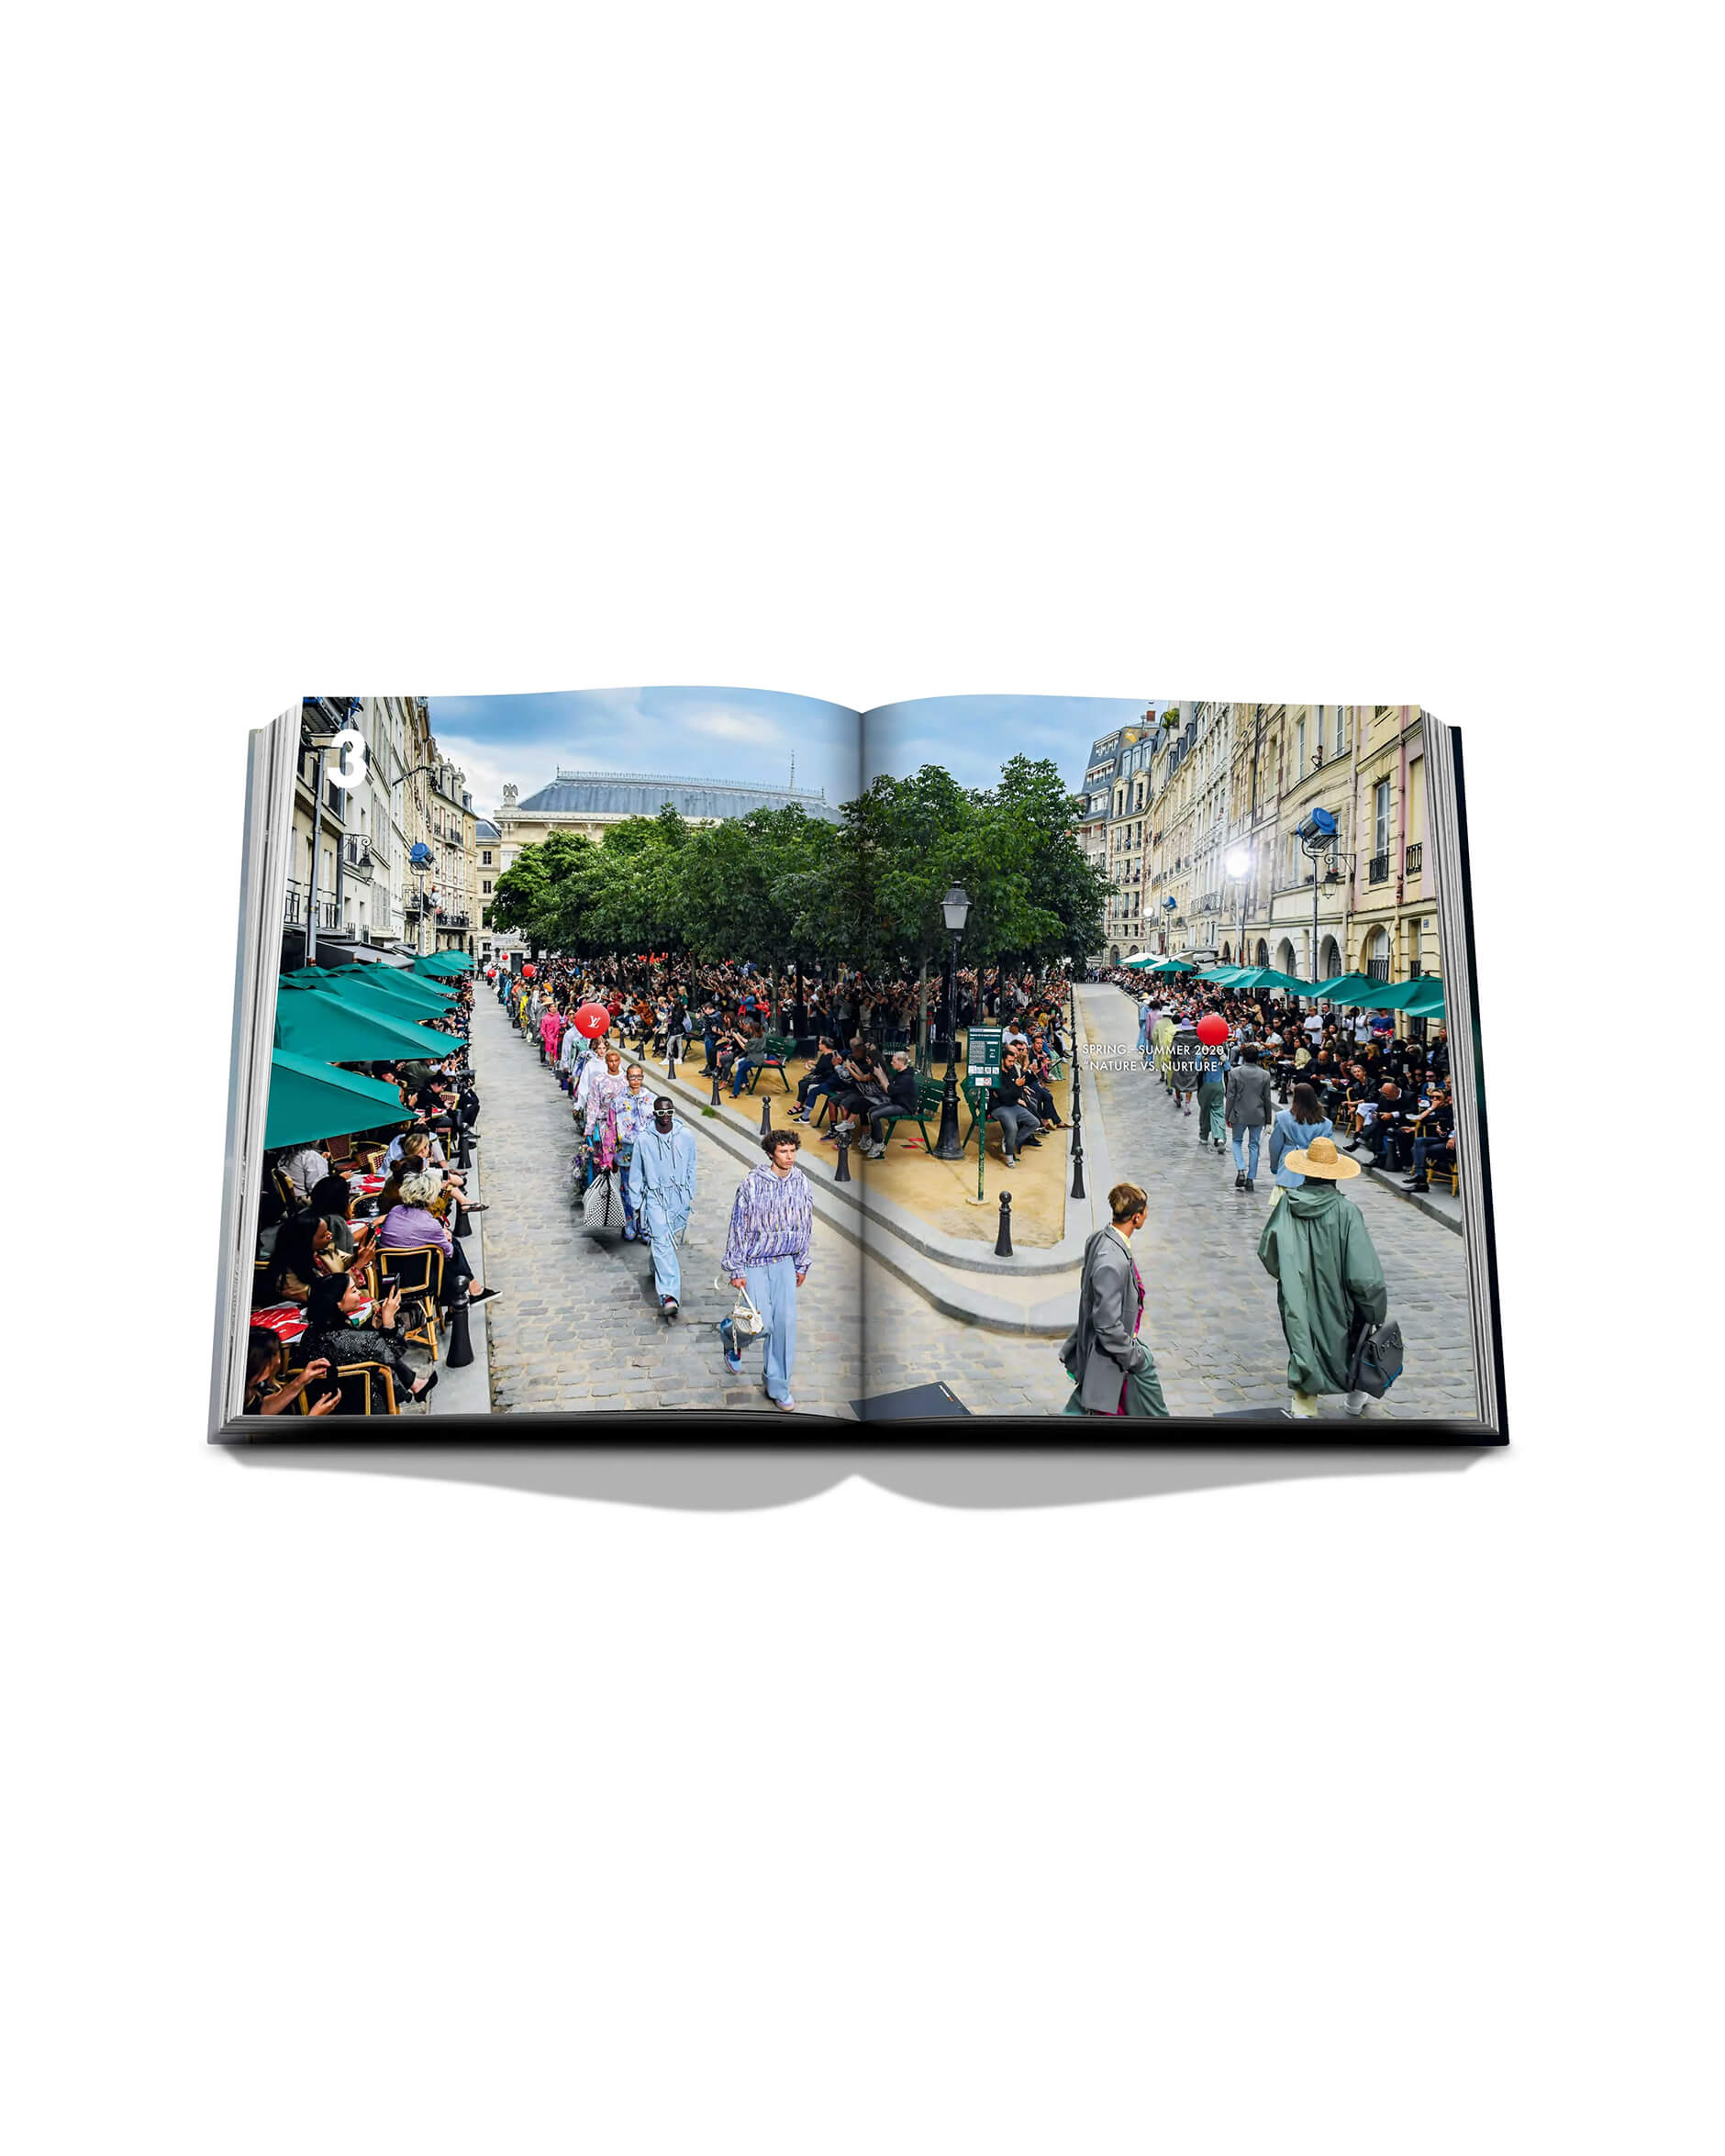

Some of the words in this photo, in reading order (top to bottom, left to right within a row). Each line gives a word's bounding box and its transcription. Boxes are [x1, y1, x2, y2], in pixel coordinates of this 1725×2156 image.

[327, 728, 368, 789] 3
[1082, 1043, 1128, 1055] SPRING
[1138, 1044, 1190, 1055] SUMMER
[1194, 1044, 1224, 1055] 2020
[1140, 1061, 1160, 1072] VS.
